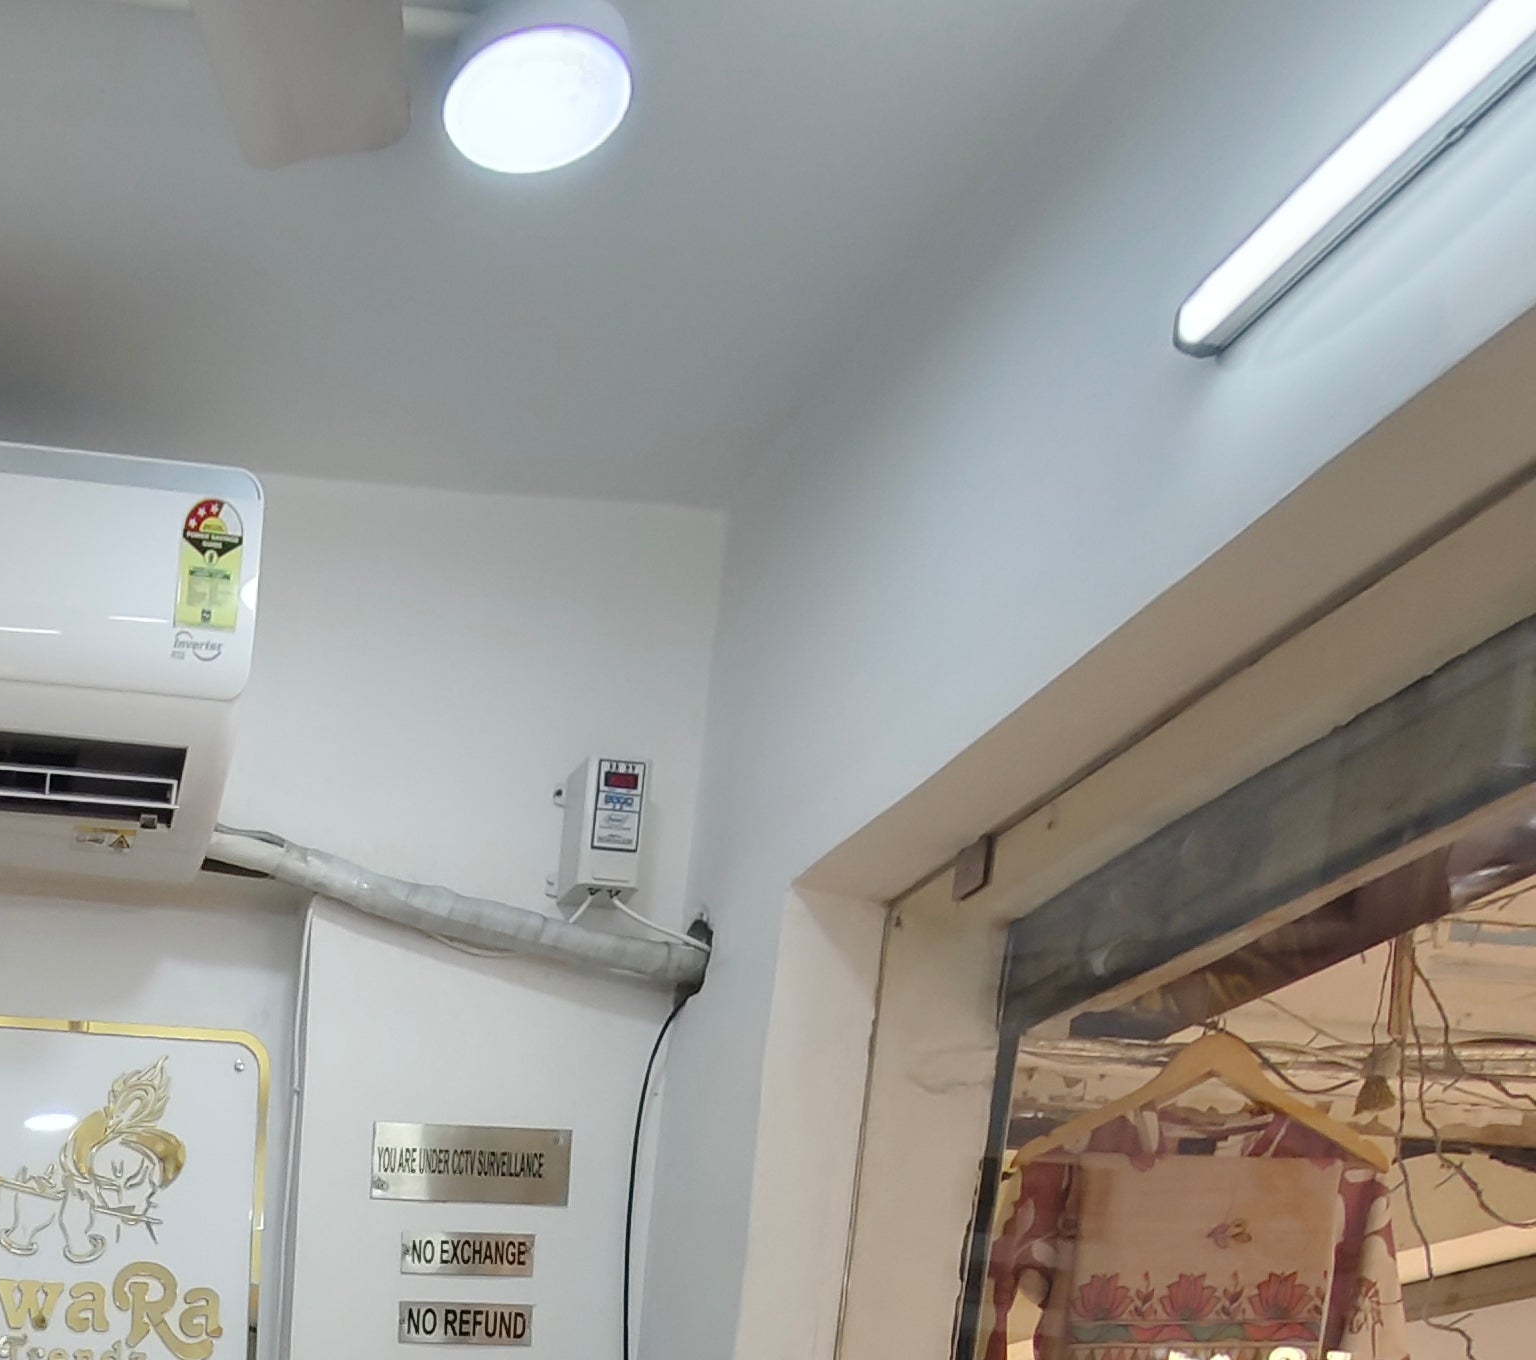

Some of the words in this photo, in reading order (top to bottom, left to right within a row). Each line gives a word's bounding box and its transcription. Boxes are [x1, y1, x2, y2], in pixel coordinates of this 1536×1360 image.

[376, 1146, 397, 1173] YOU
[397, 1147, 417, 1174] ARE
[418, 1148, 450, 1175] UNDER
[451, 1149, 477, 1176] CCTV
[477, 1150, 545, 1179] SURVEILLANCE
[411, 1239, 435, 1265] NO
[439, 1239, 527, 1266] EXCHANGE
[406, 1307, 438, 1336] NO
[443, 1308, 526, 1340] REFUND
